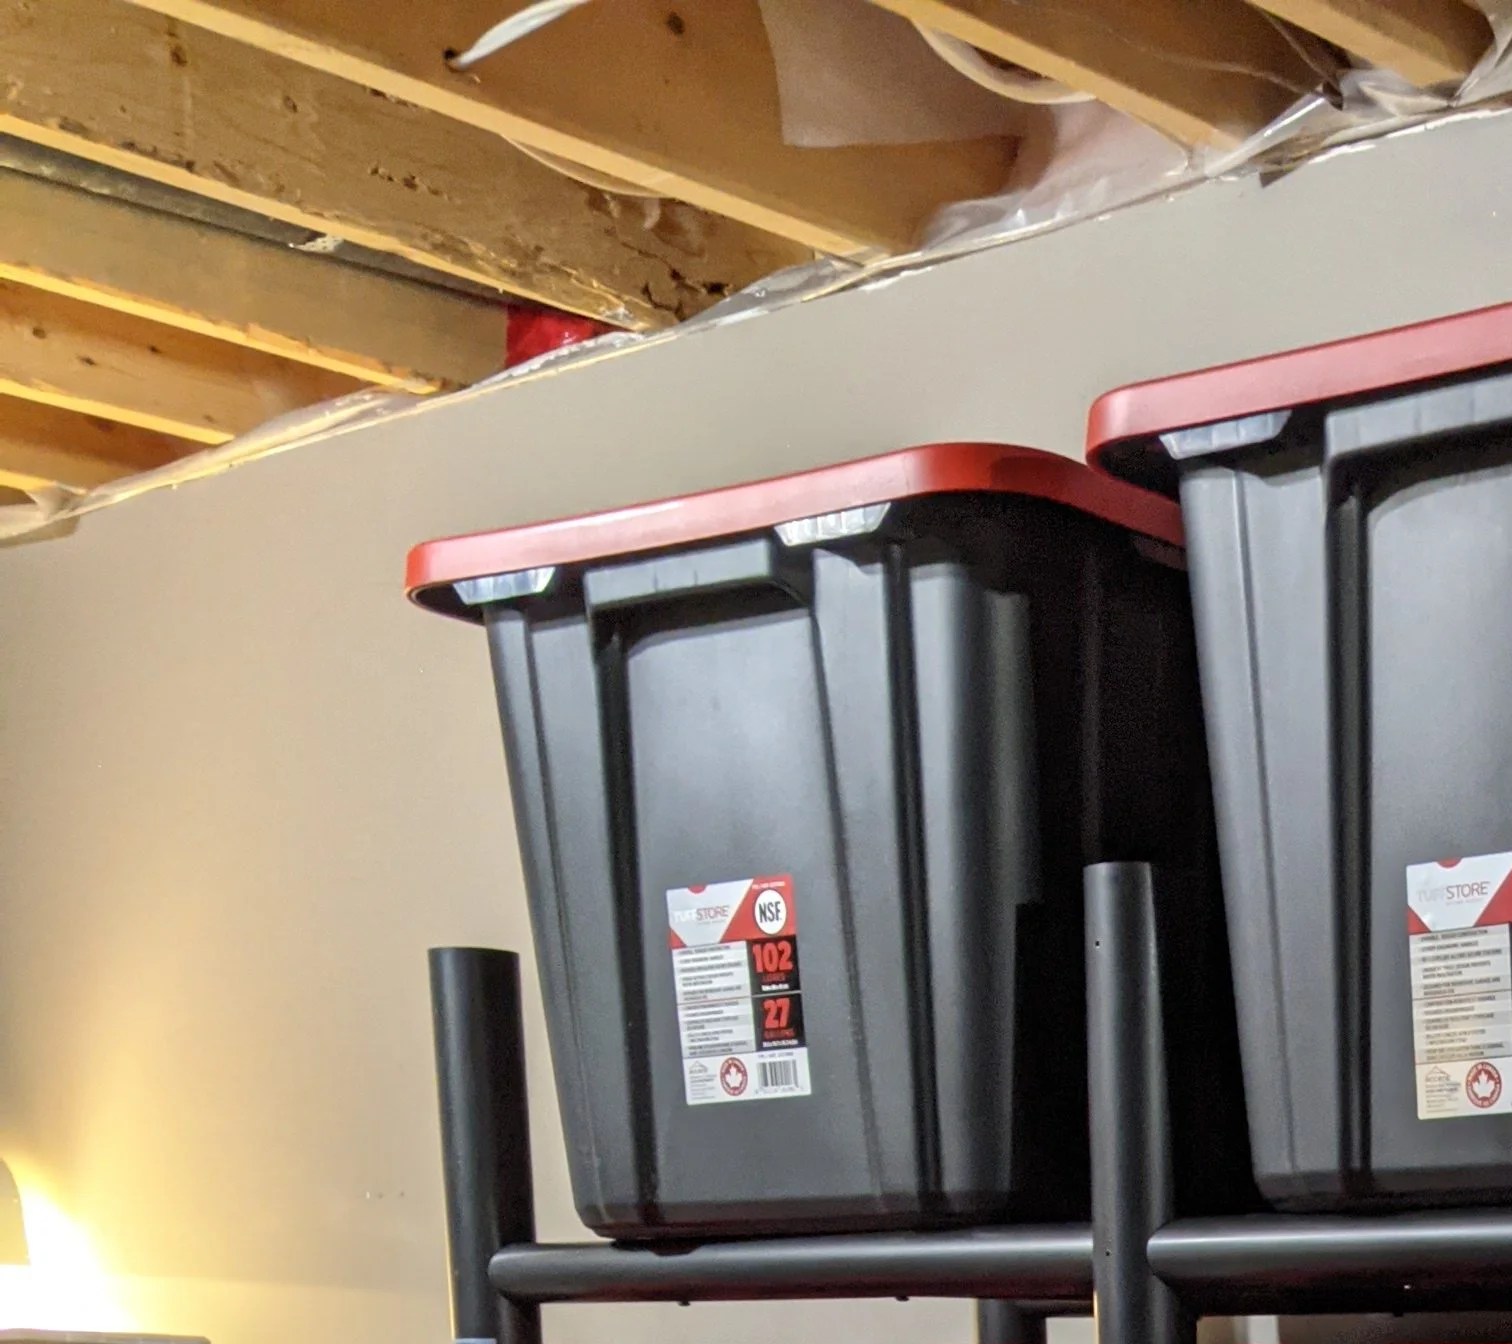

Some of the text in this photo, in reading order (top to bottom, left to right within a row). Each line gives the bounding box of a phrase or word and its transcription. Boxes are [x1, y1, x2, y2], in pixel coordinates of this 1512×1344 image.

[759, 902, 782, 924] NSF
[753, 940, 793, 973] 102
[763, 998, 791, 1029] 27
